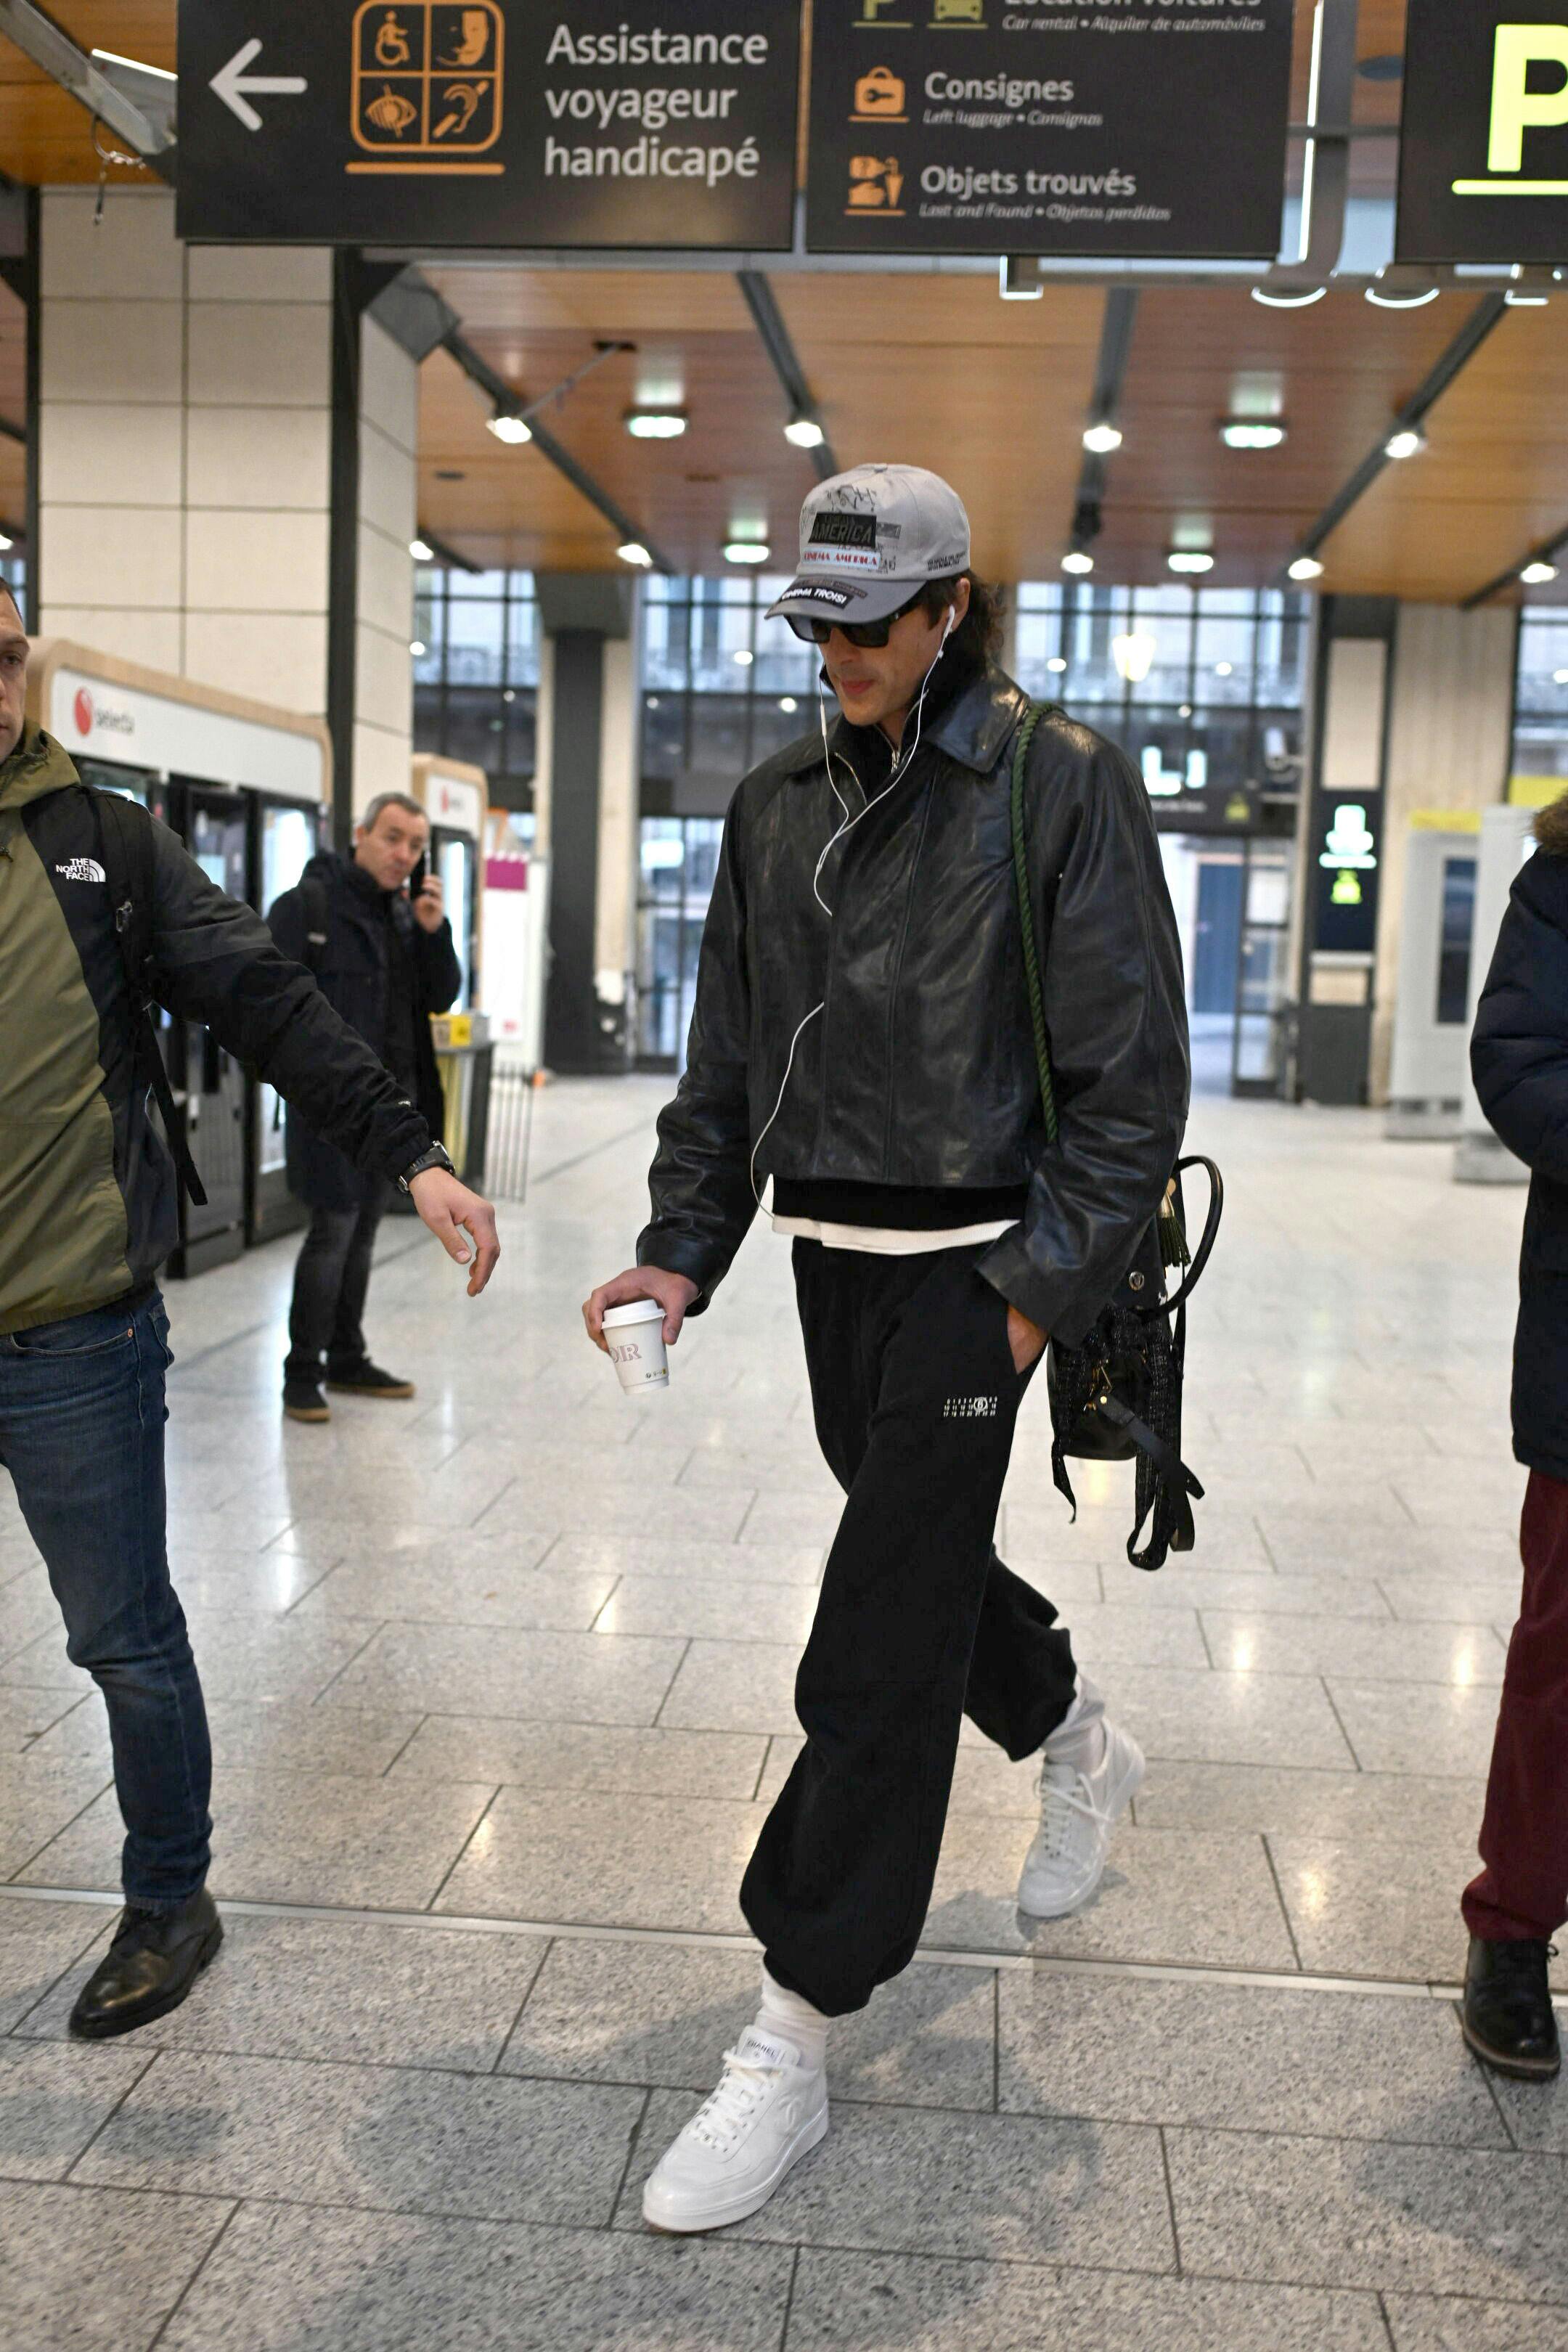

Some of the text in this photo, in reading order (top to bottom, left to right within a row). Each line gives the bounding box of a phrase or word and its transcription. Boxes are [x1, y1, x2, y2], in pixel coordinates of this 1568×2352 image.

[1090, 15, 1151, 34] Alquiler
[1151, 17, 1173, 32] de
[547, 25, 769, 66] Assistance
[924, 72, 1075, 108] Consignes
[1488, 25, 1568, 173] P
[546, 88, 738, 131] voyageur
[923, 109, 955, 126] Left
[955, 110, 1016, 128] luggage
[545, 136, 760, 188] handicapé
[921, 166, 1138, 201] Objets trouvés
[919, 203, 953, 219] Lost
[810, 521, 873, 543] AMERICA
[814, 587, 847, 605] TROISI
[55, 865, 89, 874] NORTH
[65, 872, 90, 882] FACE
